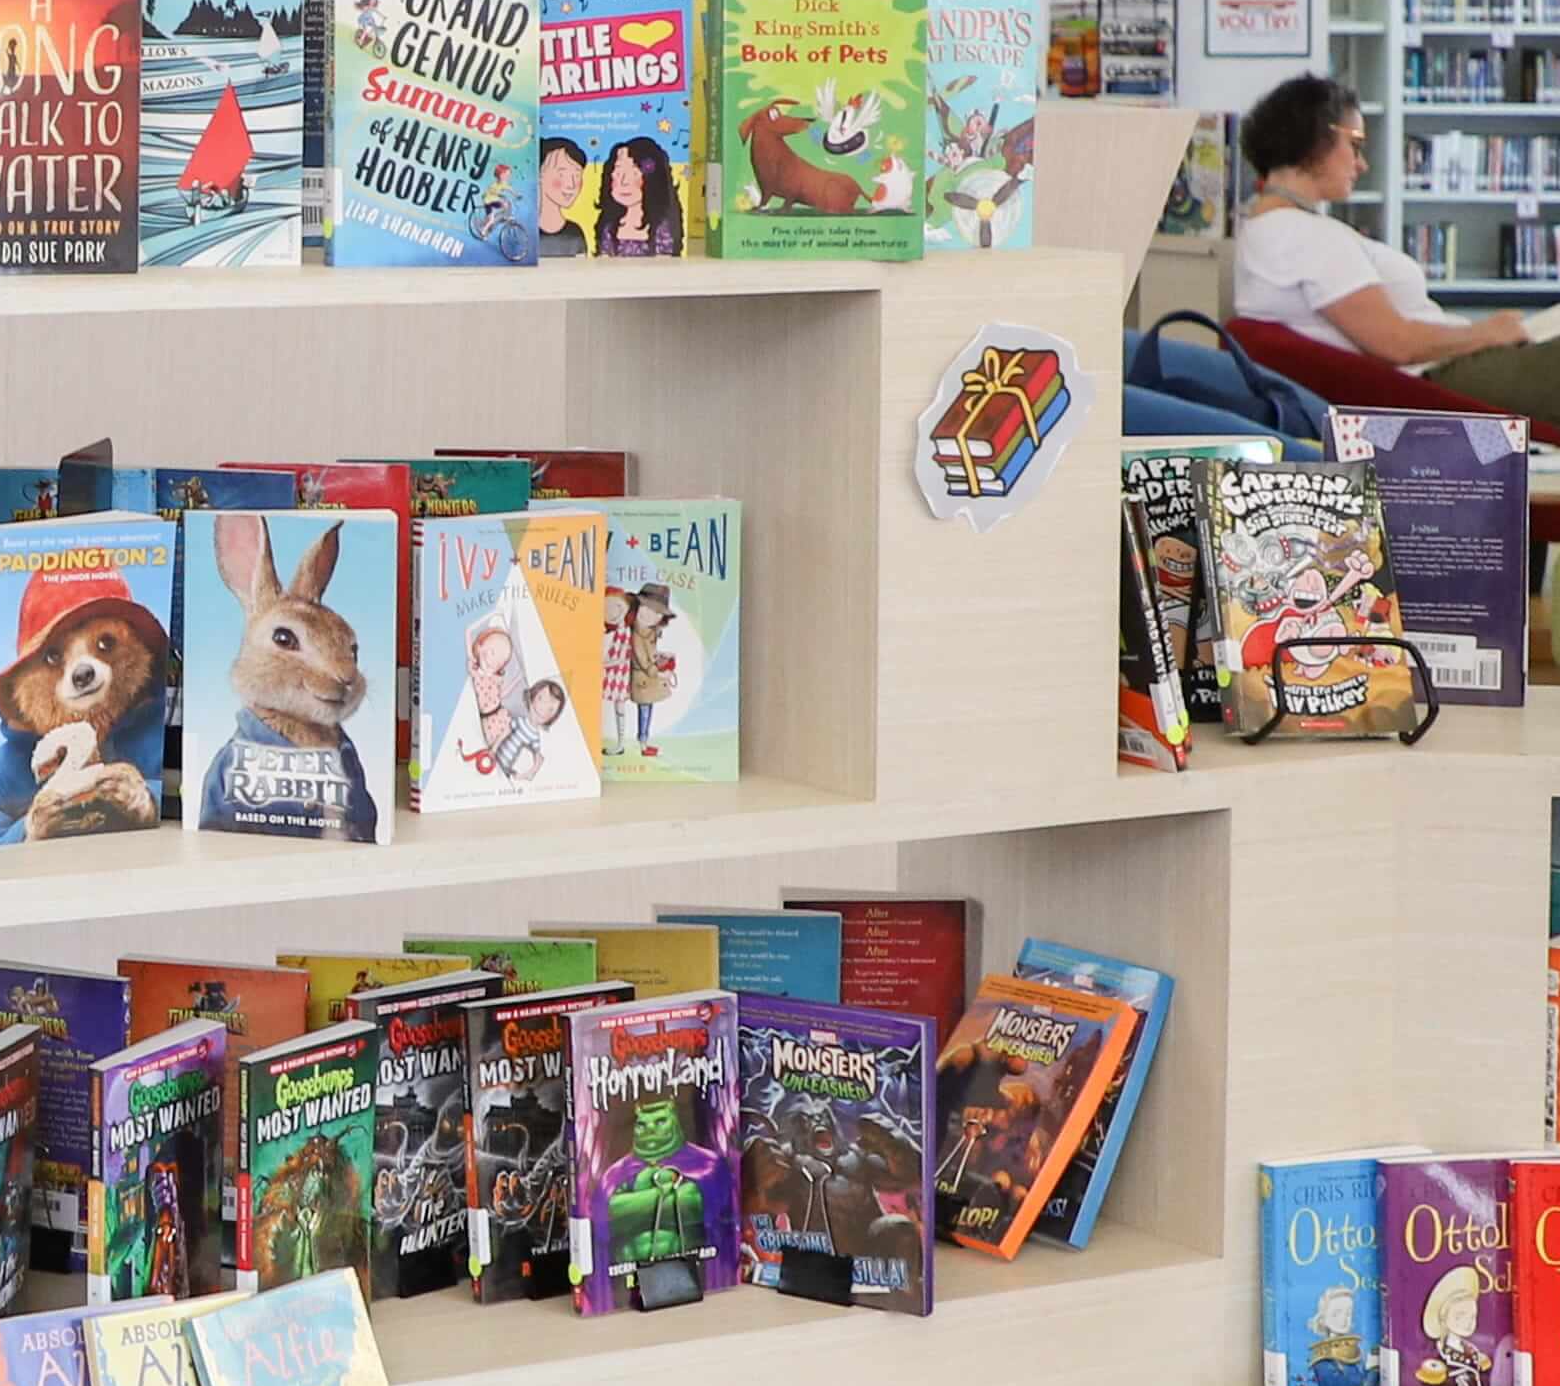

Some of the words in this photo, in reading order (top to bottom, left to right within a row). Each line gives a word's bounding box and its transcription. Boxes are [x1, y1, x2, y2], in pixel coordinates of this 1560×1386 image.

[754, 19, 796, 41] King
[390, 20, 516, 103] GENIUS
[741, 44, 798, 64] Book
[805, 45, 833, 65] of
[838, 44, 888, 65] Pets
[77, 98, 122, 148] TO
[360, 65, 515, 140] Summer
[368, 119, 391, 143] of
[392, 119, 492, 180] HENRY
[355, 147, 482, 214] HOOBLER
[28, 241, 58, 264] SUE
[64, 240, 106, 263] PARK
[1222, 488, 1366, 518] UNDERPANTS
[151, 547, 168, 566] 2
[528, 524, 597, 593] BEAN
[233, 743, 343, 775] PETER
[224, 774, 355, 808] RABBIT
[275, 1065, 355, 1110] Goosebumps
[591, 1037, 724, 1111] HorrorLand
[773, 1038, 876, 1093] MONSTERS
[782, 1072, 868, 1100] UNLEASHED!
[257, 1112, 303, 1145] MOST
[304, 1081, 372, 1132] WANTED
